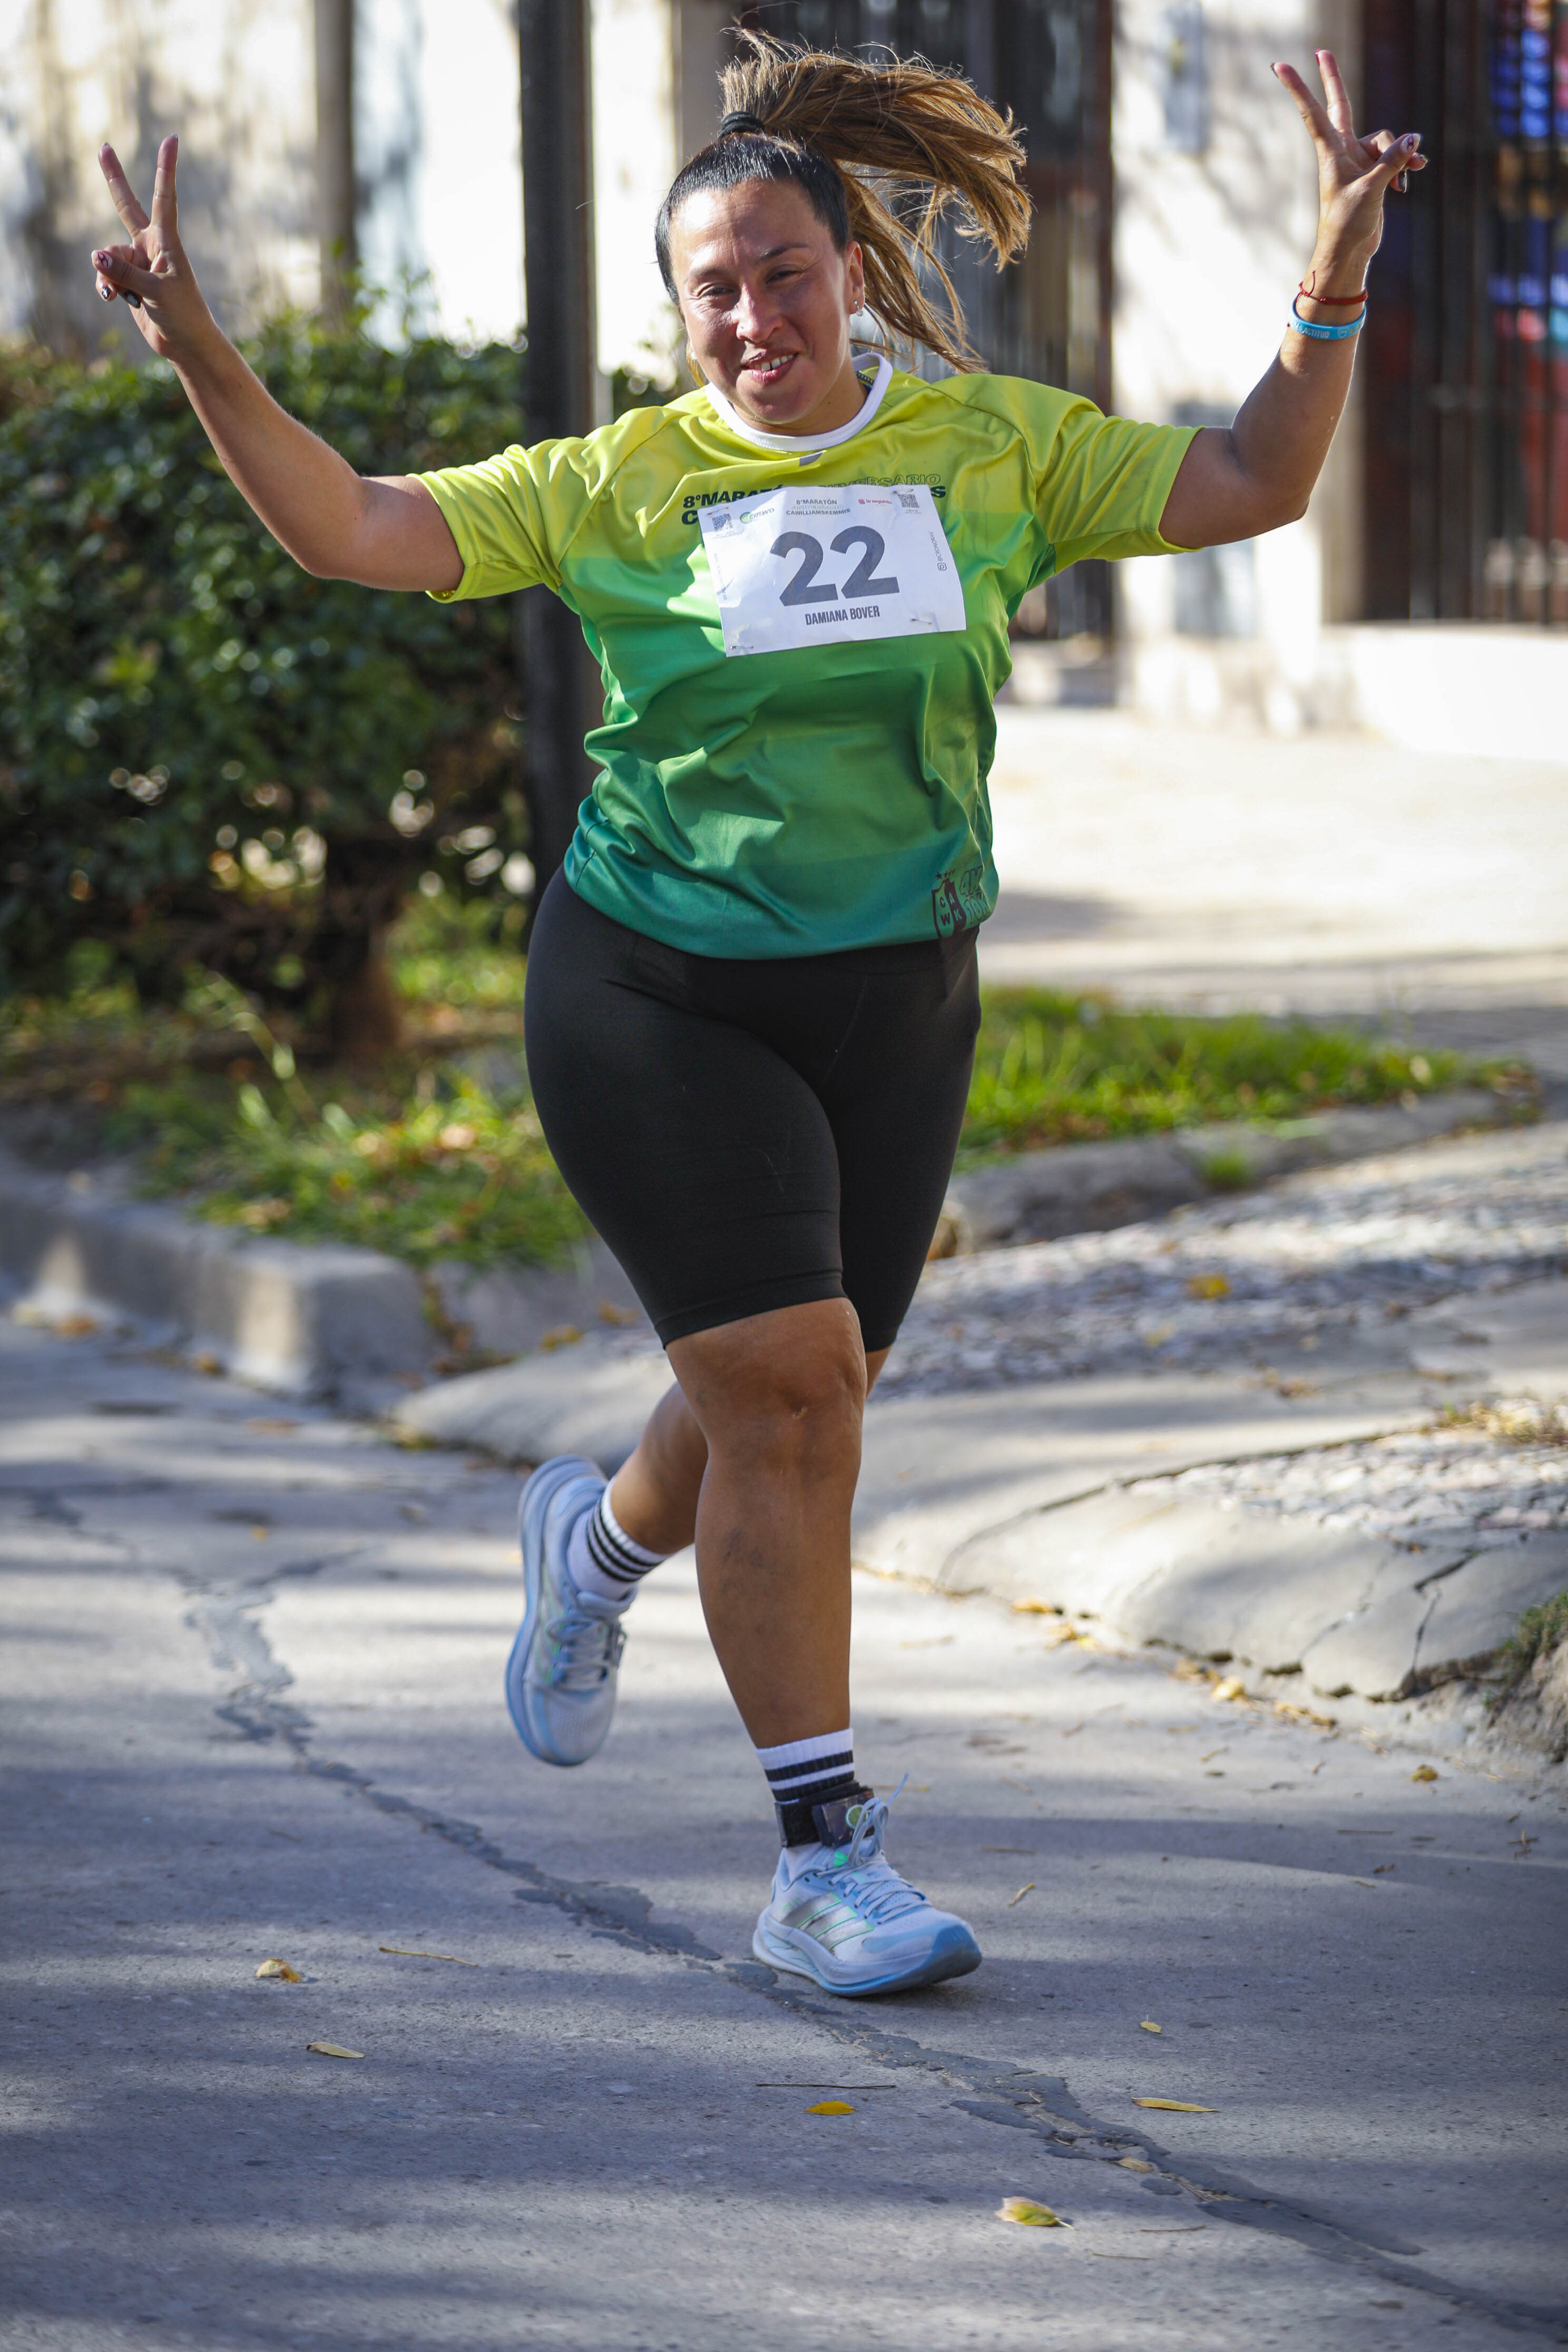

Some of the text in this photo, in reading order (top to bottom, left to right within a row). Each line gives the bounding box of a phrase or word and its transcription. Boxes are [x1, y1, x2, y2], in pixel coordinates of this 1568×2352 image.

[770, 525, 900, 606] 22
[805, 605, 880, 626] DAMIANA BOVER
